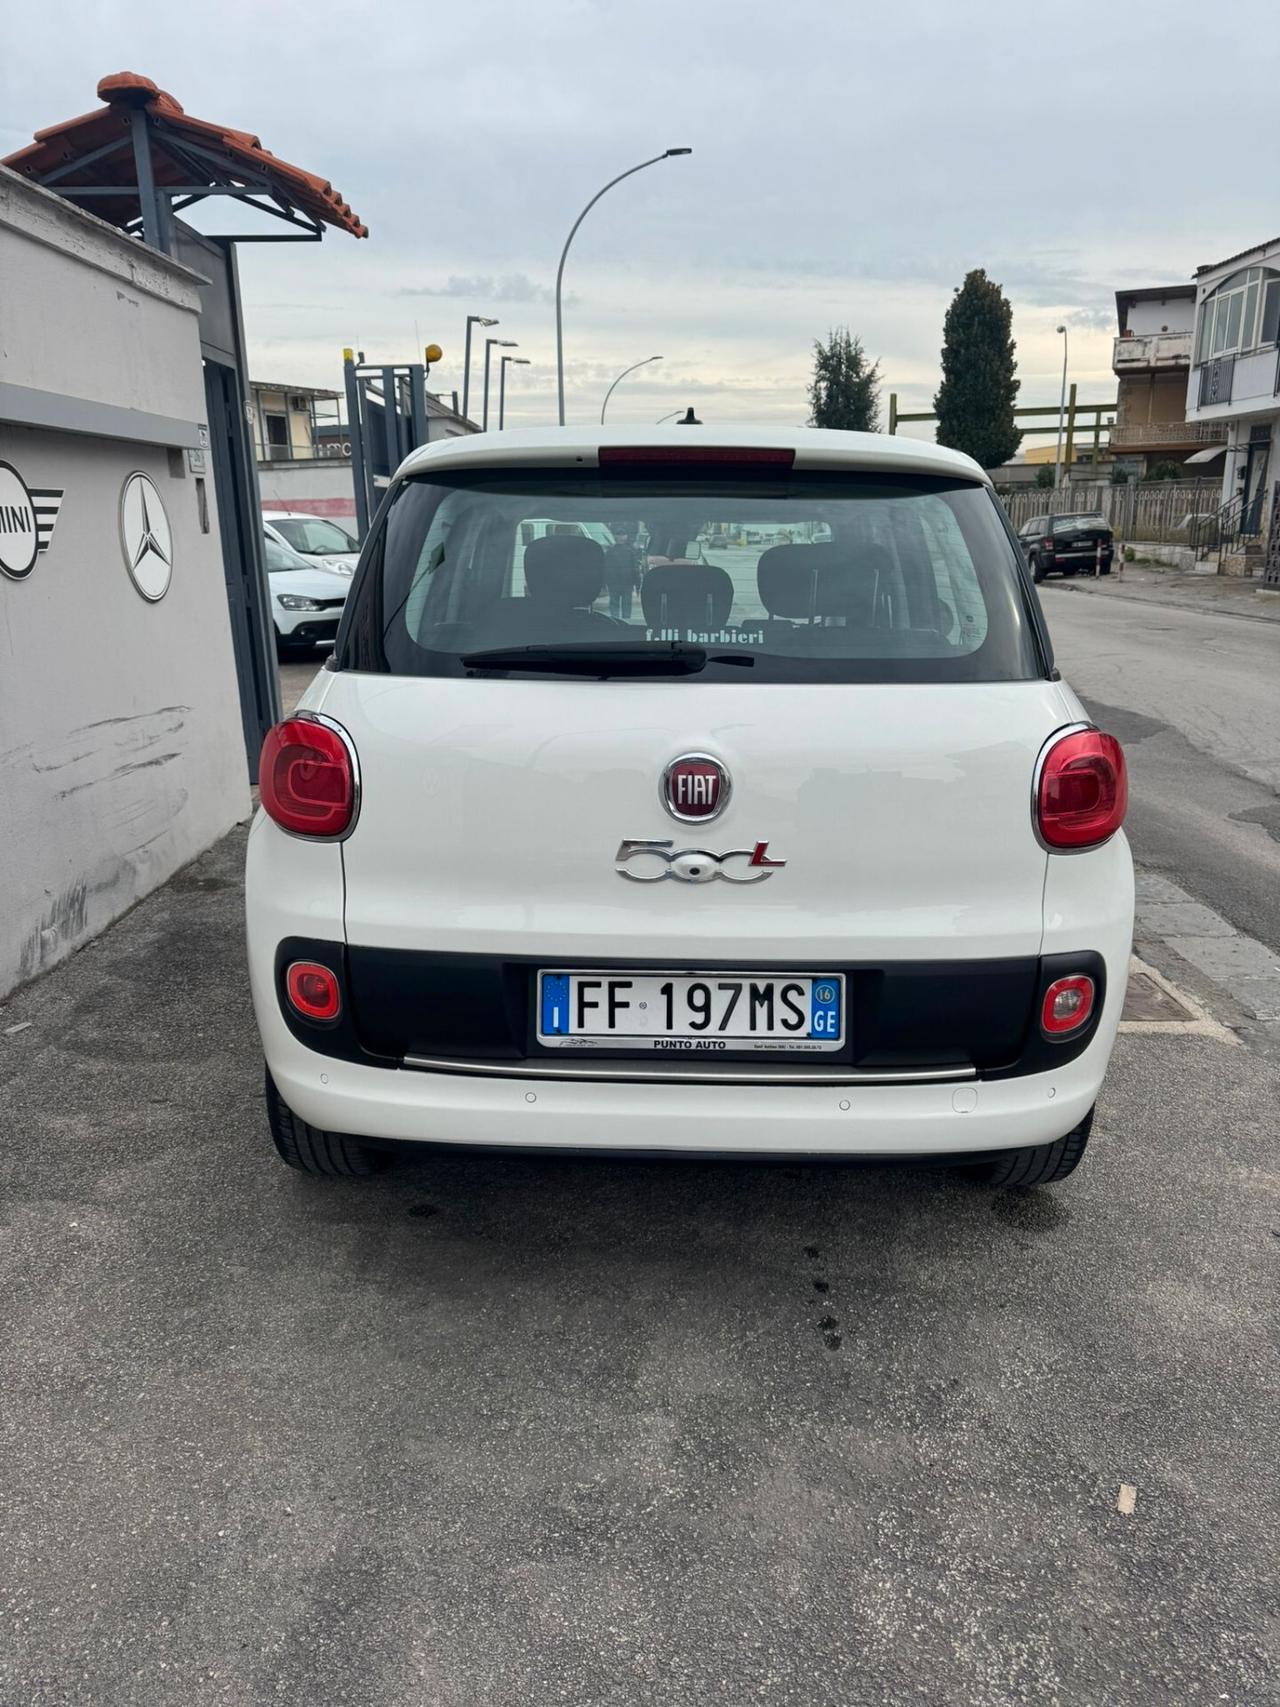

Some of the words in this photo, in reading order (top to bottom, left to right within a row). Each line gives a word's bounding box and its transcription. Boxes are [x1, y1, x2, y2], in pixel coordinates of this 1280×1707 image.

[687, 629, 764, 644] barbieri
[677, 774, 716, 805] FIAT
[819, 989, 831, 1000] 16
[577, 981, 633, 1029] FF
[660, 983, 806, 1031] 197MS
[814, 1010, 836, 1033] GE
[653, 1040, 692, 1049] PUNTO
[695, 1040, 726, 1050] AUTO
